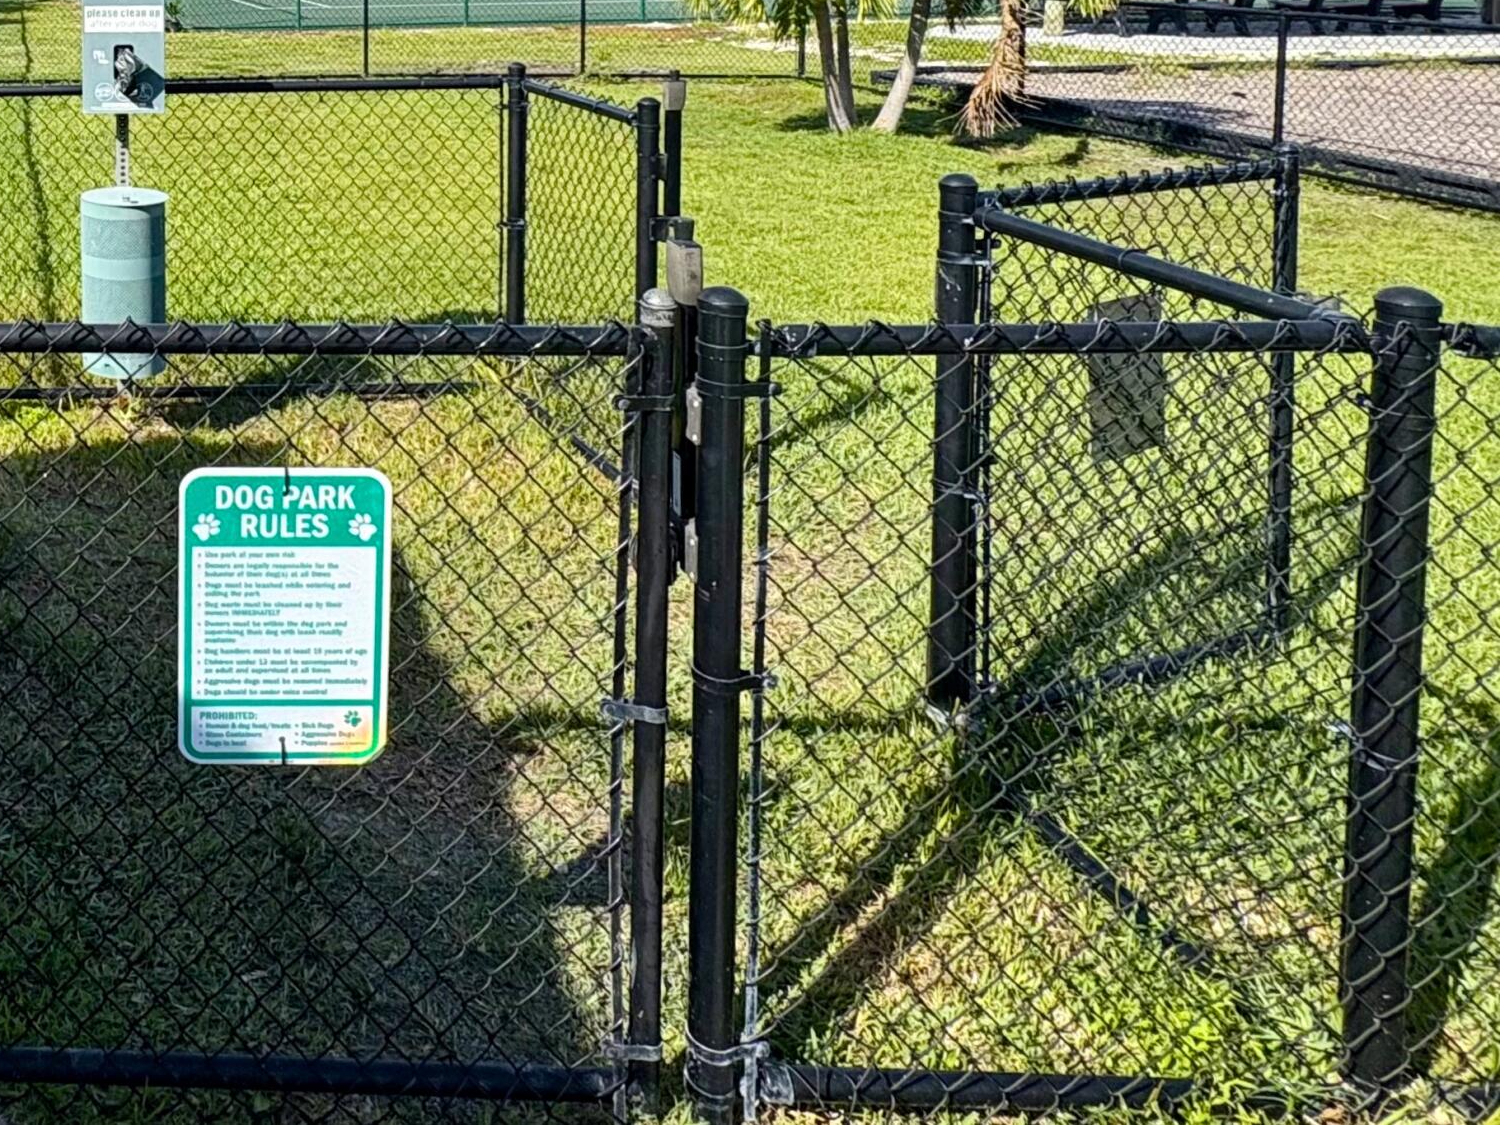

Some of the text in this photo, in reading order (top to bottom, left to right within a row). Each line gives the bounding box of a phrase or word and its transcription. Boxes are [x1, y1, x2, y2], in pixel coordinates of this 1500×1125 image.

[87, 9, 161, 19] please clean up
[90, 20, 158, 29] after your dog
[215, 485, 356, 510] DOG PARK
[240, 513, 329, 538] RULES
[200, 712, 257, 720] PROHIBITED:
